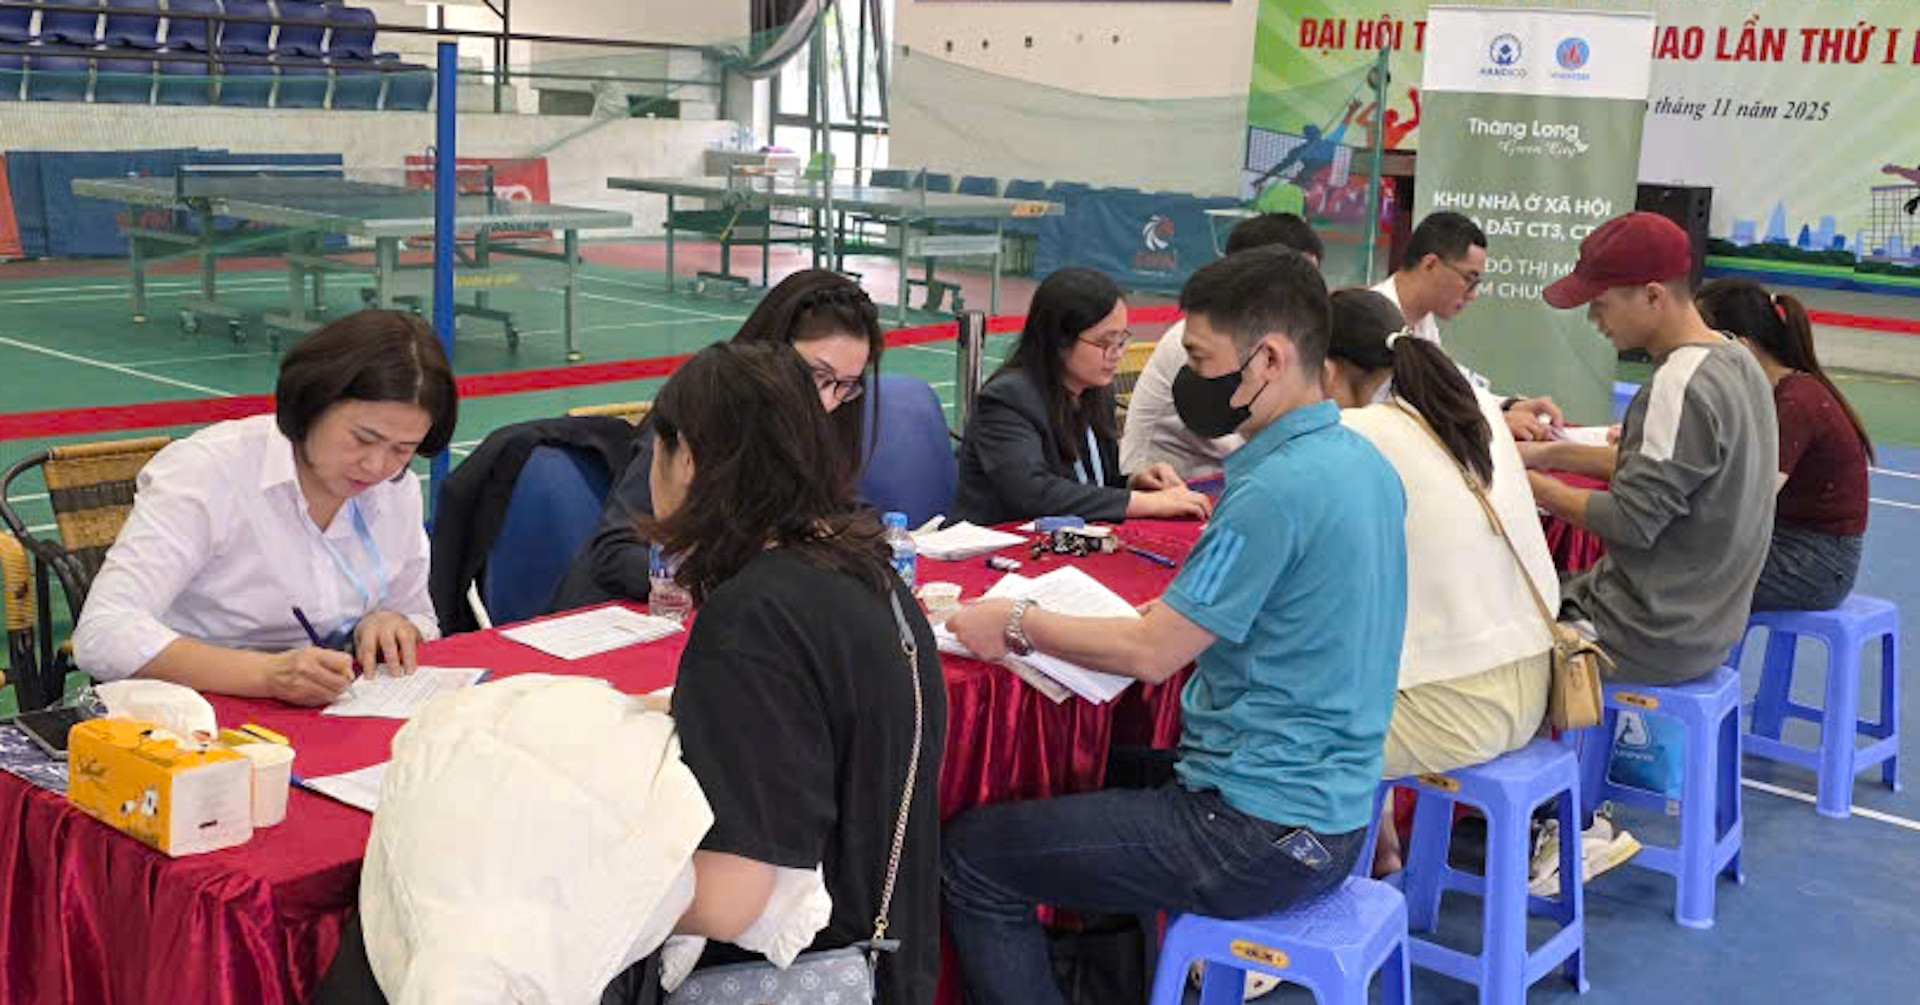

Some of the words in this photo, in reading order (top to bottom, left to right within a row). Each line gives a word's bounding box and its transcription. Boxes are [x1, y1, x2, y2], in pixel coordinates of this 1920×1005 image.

[1299, 18, 1346, 55] ĐẠI
[1715, 14, 1787, 62] LẦN
[1800, 20, 1877, 64] THỨ
[1881, 28, 1902, 64] I
[1653, 96, 1706, 121] tháng
[1711, 98, 1732, 117] 11
[1736, 102, 1779, 119] năm
[1783, 100, 1832, 121] 2025
[1531, 119, 1580, 142] Long
[1432, 191, 1476, 208] KHU
[1477, 191, 1522, 211] NHÀ
[1544, 195, 1572, 215] XÃ
[1574, 195, 1612, 218] HỘI
[1486, 215, 1525, 236] ĐẤT
[1517, 258, 1549, 279] THỊ
